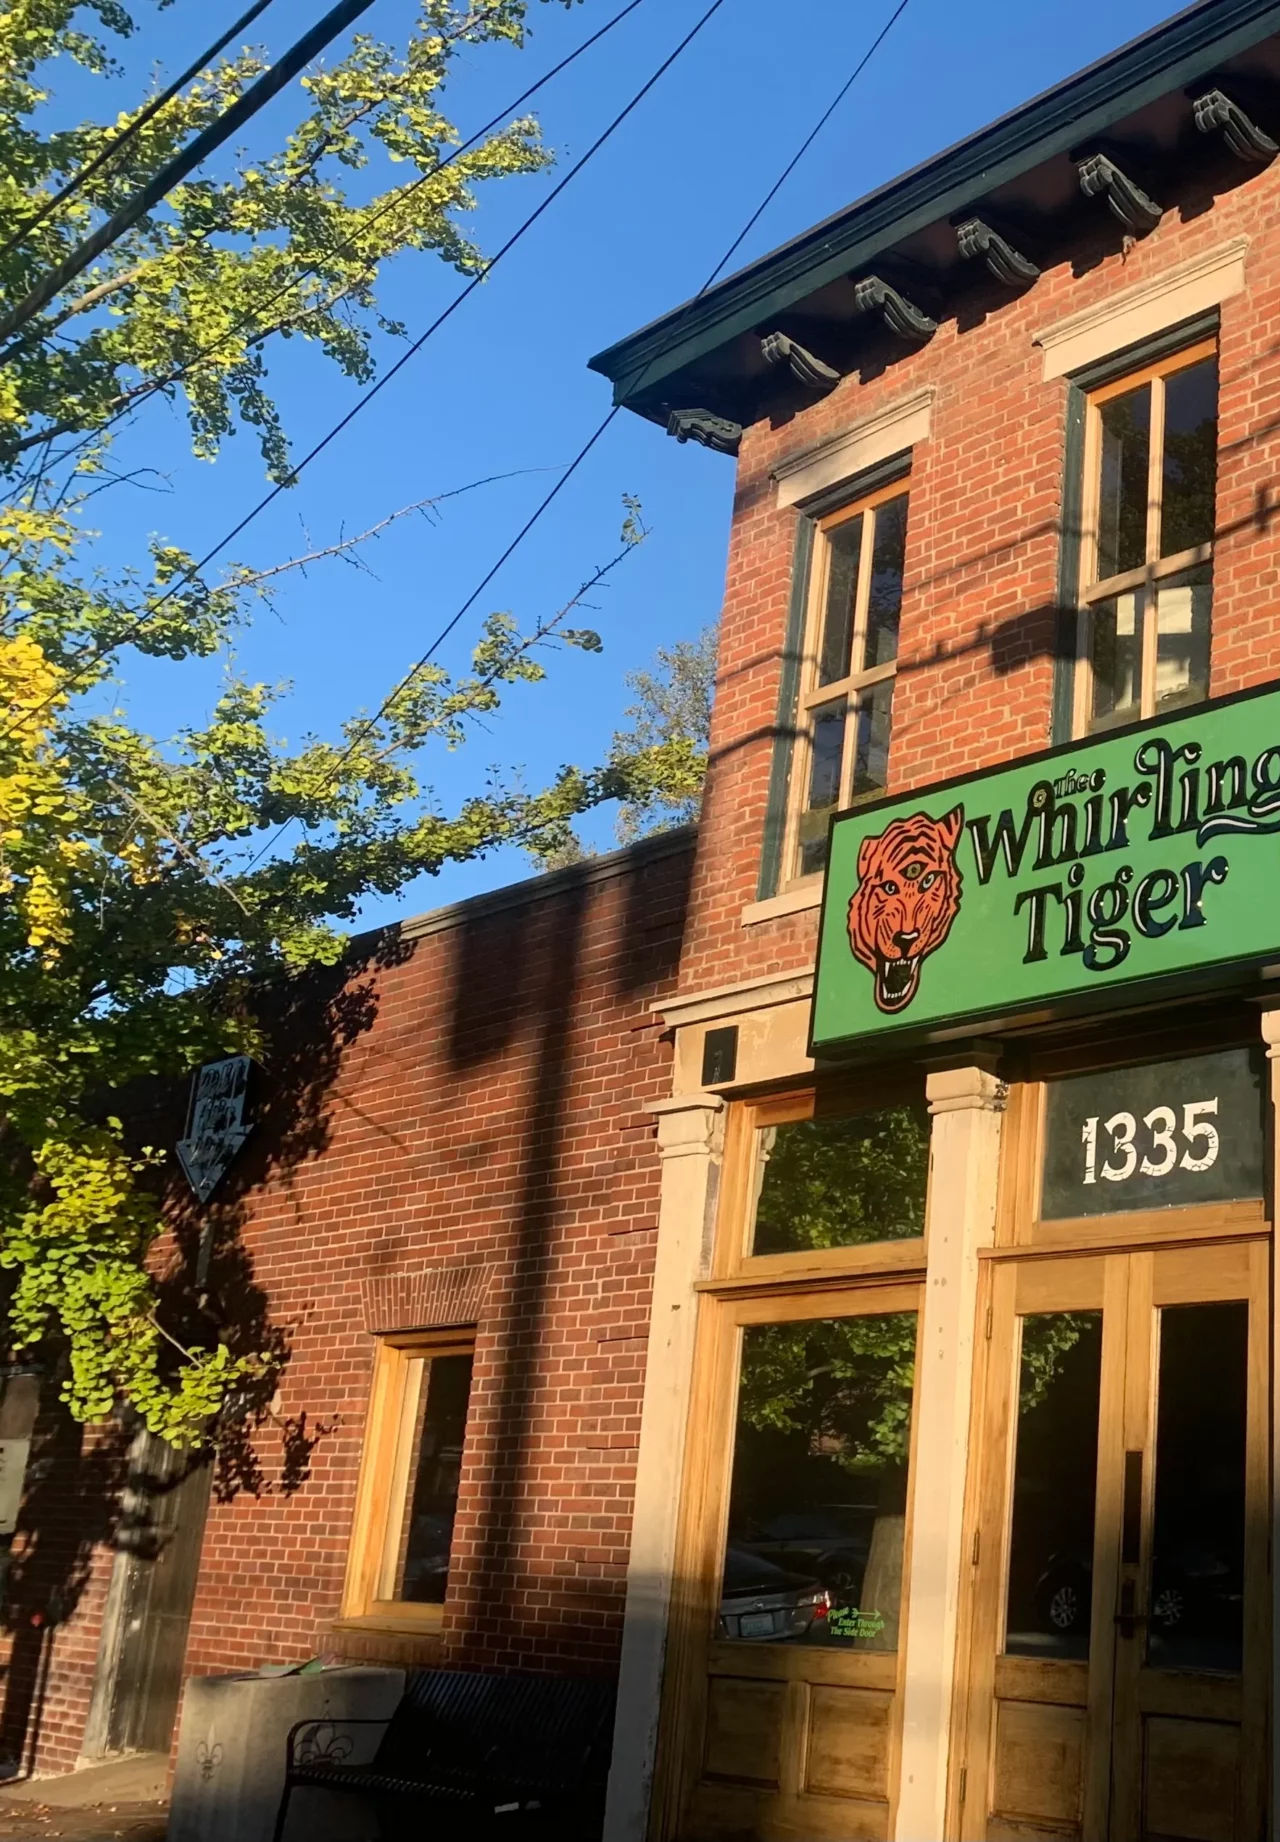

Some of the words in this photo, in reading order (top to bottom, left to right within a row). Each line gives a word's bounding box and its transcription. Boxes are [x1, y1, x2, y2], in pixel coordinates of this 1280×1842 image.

[1053, 768, 1089, 799] The
[1013, 855, 1229, 971] Tiger
[1081, 1096, 1220, 1185] 1335
[830, 1626, 843, 1635] The
[843, 1628, 859, 1637] Side
[859, 1629, 876, 1638] Door
[838, 1618, 856, 1627] Enter
[857, 1619, 885, 1631] Through
